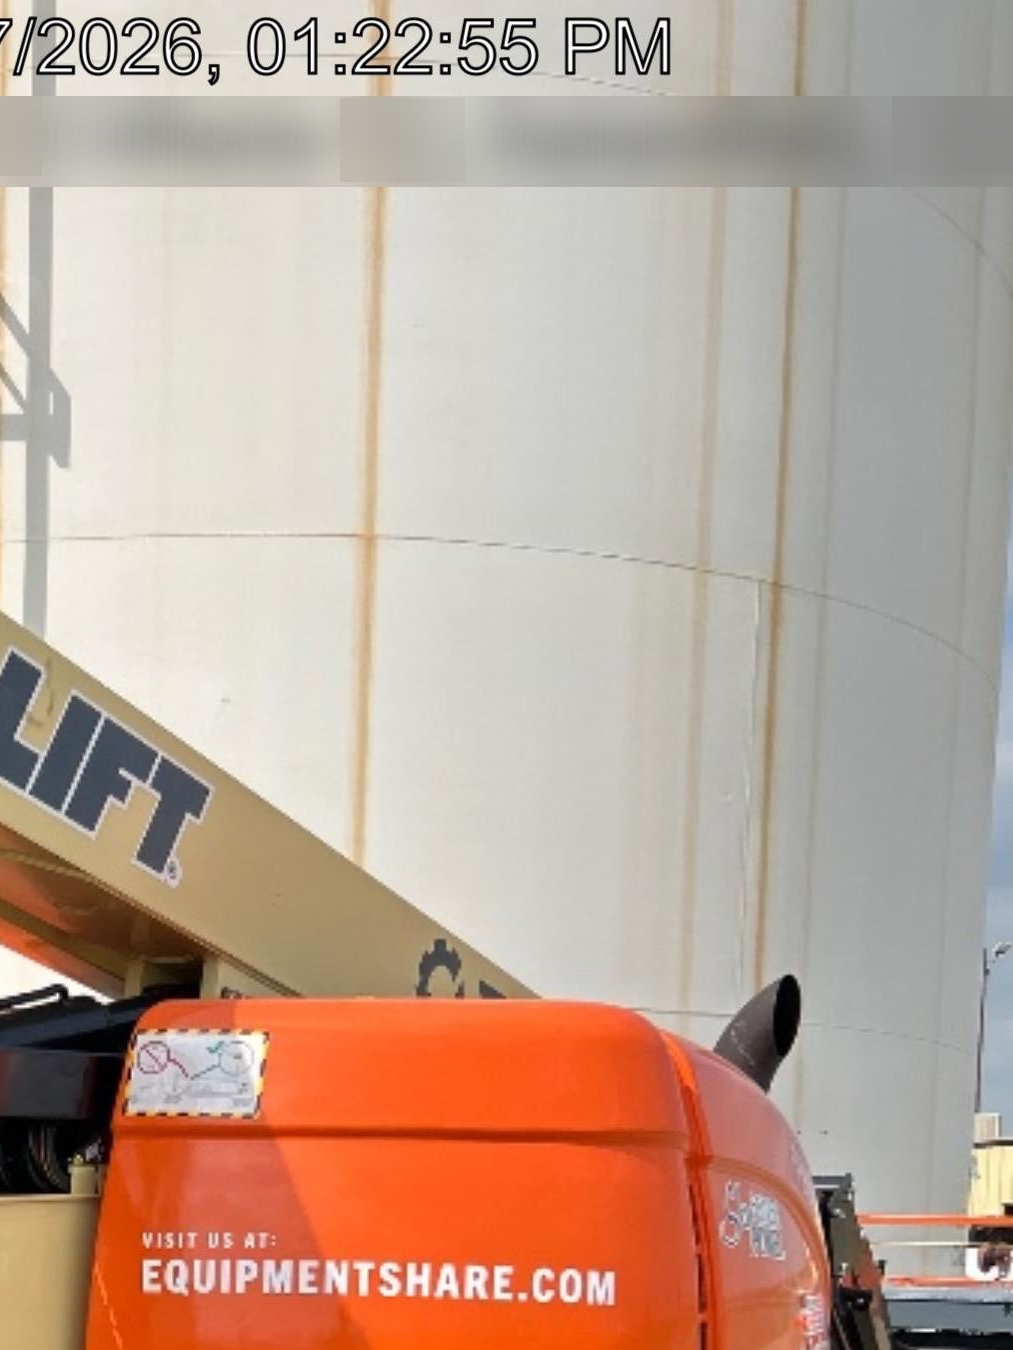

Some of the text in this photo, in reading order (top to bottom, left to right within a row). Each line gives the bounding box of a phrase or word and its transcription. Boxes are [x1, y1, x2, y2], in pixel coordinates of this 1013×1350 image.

[141, 1231, 278, 1250] VISIT US AT:
[141, 1257, 617, 1306] EQUIPMENTSHARE.COM
